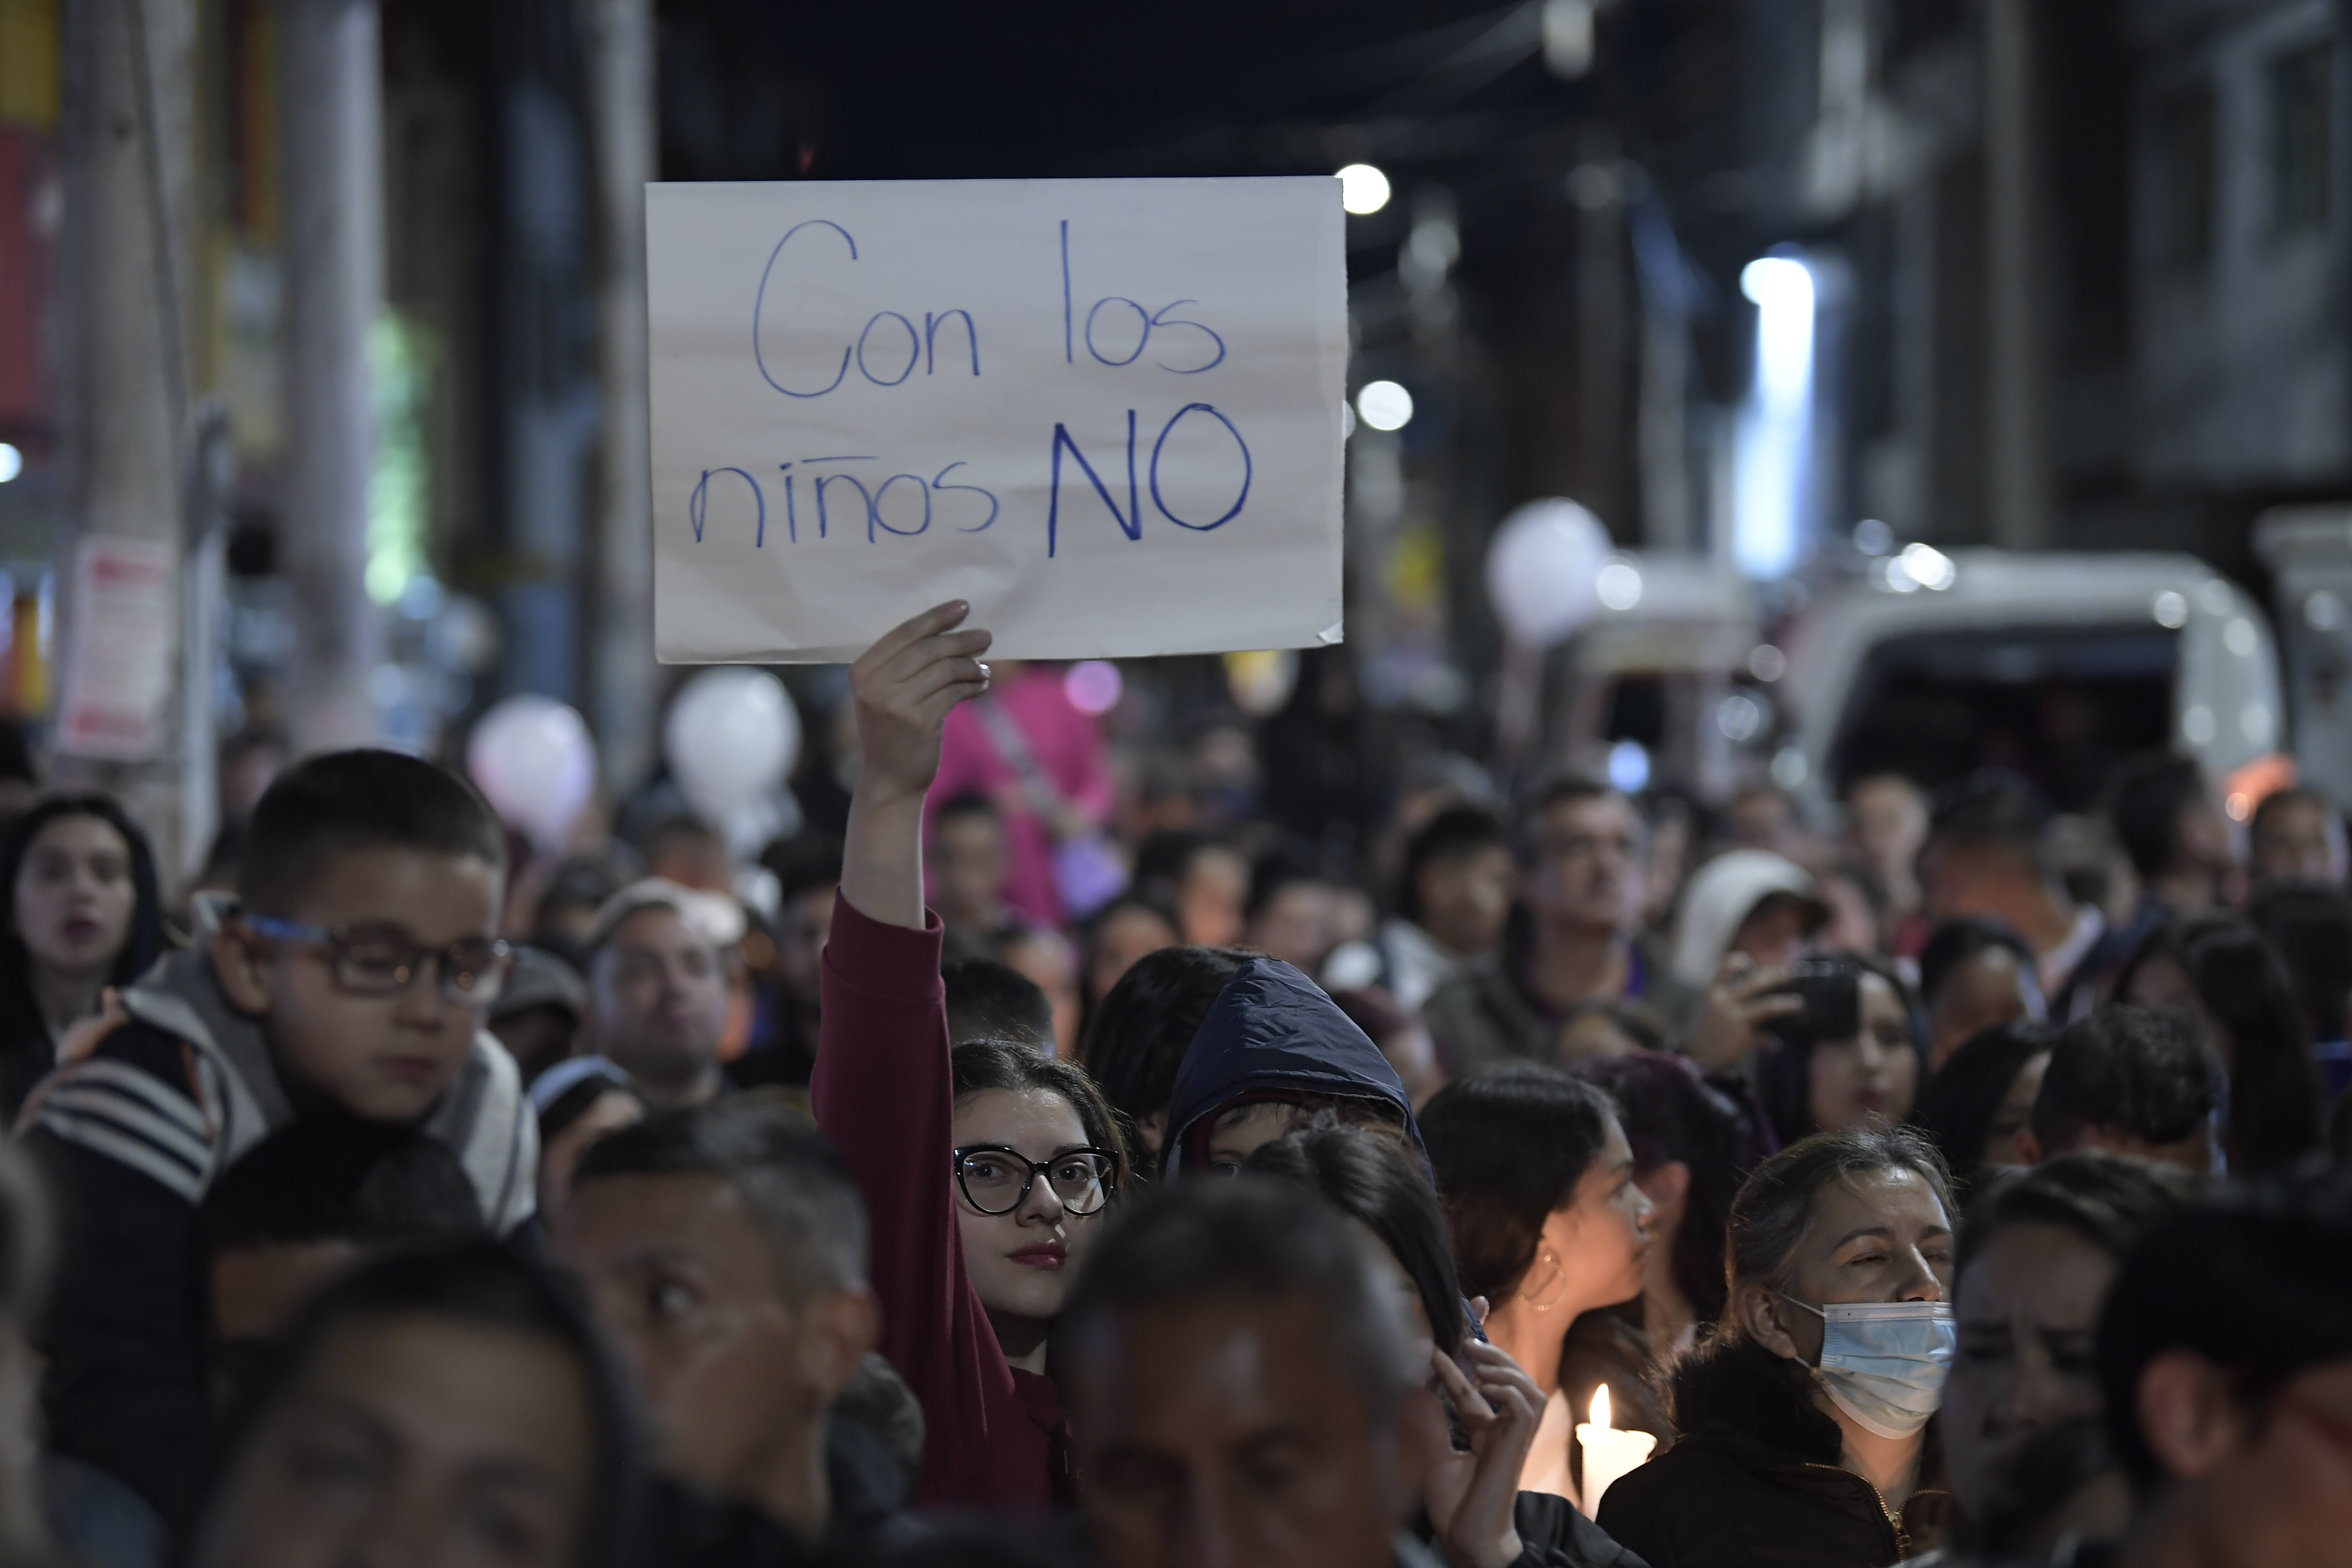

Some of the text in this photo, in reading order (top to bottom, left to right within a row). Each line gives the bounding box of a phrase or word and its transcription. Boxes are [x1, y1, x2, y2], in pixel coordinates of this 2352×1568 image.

[755, 219, 1226, 398] Con los
[690, 403, 1252, 558] niños NO
